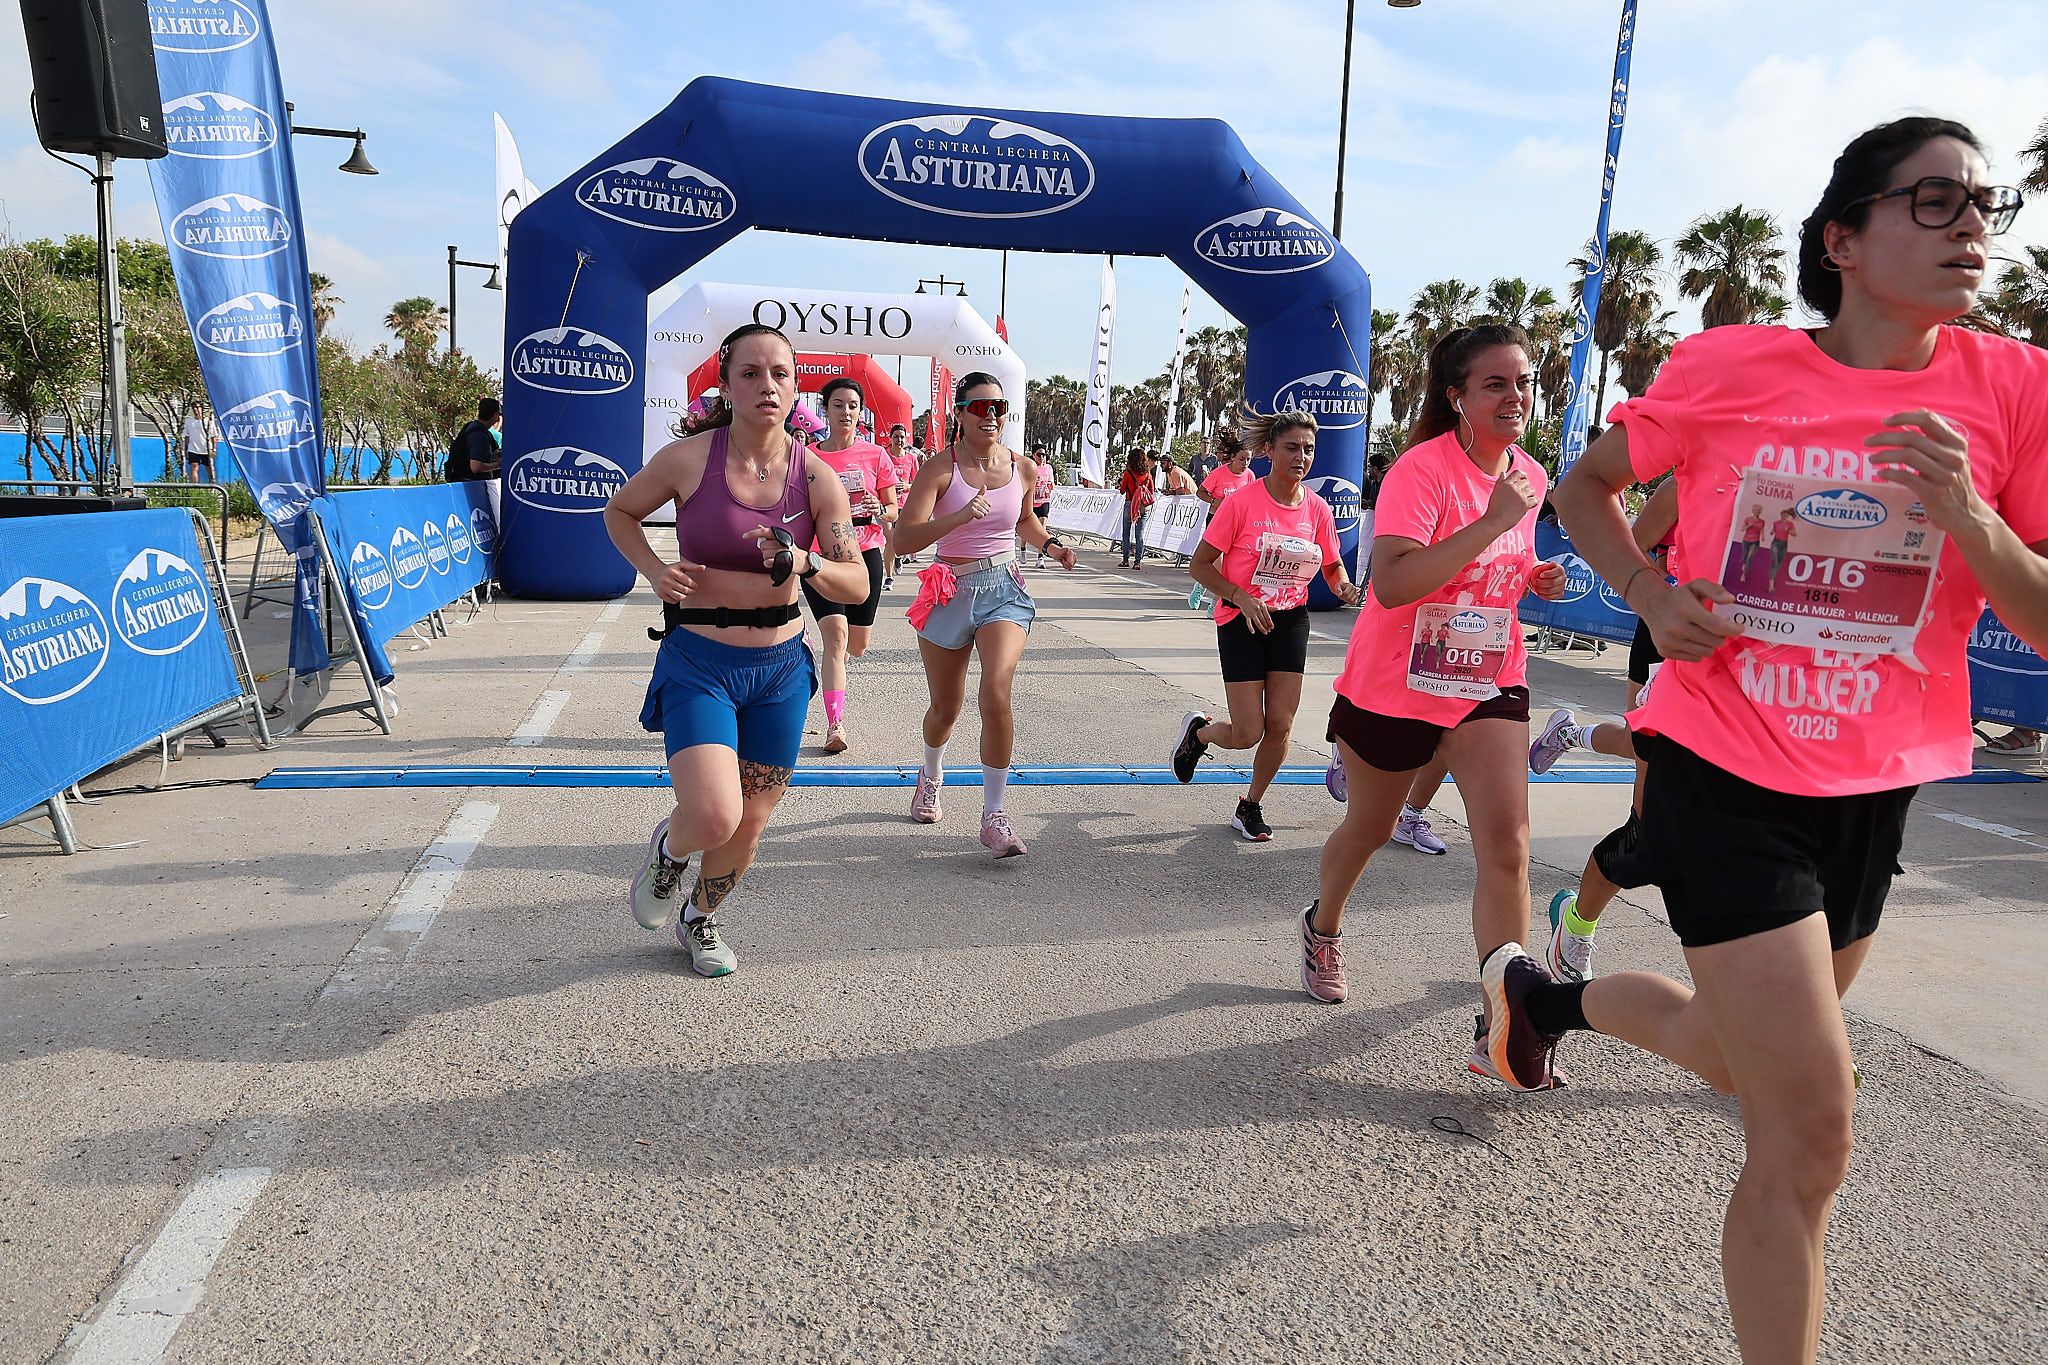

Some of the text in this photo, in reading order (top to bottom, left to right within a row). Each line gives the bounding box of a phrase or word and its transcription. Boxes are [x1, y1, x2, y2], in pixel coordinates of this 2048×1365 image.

[914, 138, 1071, 162] CENTRAL LECHERA
[875, 137, 1077, 197] ASTURIANA
[585, 178, 724, 220] ASTURIANA
[613, 177, 724, 199] CENTRAL LECHERA
[1205, 232, 1329, 258] ASTURIANA
[1229, 230, 1320, 239] CENTRAL LECHERA
[752, 298, 913, 341] OYSHO
[653, 331, 704, 344] OYSHO
[533, 347, 625, 364] CENTRAL LECHERA
[955, 345, 1002, 356] OYSHO
[516, 348, 628, 384] ASTURIANA
[1281, 390, 1368, 415] ASTURIAN
[1301, 389, 1341, 397] CENTRAL
[531, 466, 621, 481] CENTRAL LECHERA
[1756, 485, 1794, 501] SUMA
[1163, 503, 1200, 530] OYSHO
[1801, 500, 1880, 522] ASTURIANA
[1278, 560, 1301, 571] 016
[1788, 554, 1867, 589] 016
[132, 585, 163, 602] CENTRAL
[1803, 589, 1840, 605] 1816
[1426, 610, 1448, 619] SUMA
[1736, 592, 1779, 611] CARRERA
[1781, 601, 1794, 612] DE
[1796, 603, 1810, 615] LA
[1811, 605, 1846, 618] MUJER
[1854, 611, 1899, 624] VALENCIA
[6, 606, 90, 642] CENTRAL LECHERA
[1452, 618, 1486, 630] ASTURIANA
[1733, 611, 1796, 635] OYSHO
[1834, 630, 1893, 645] Santander
[0, 622, 105, 685] ASTURIANA
[1446, 648, 1484, 666] 016
[1418, 669, 1442, 680] CARRERA
[1737, 653, 1880, 715] MUJER
[1417, 680, 1450, 692] OYSHO
[1785, 713, 1839, 741] 2026
